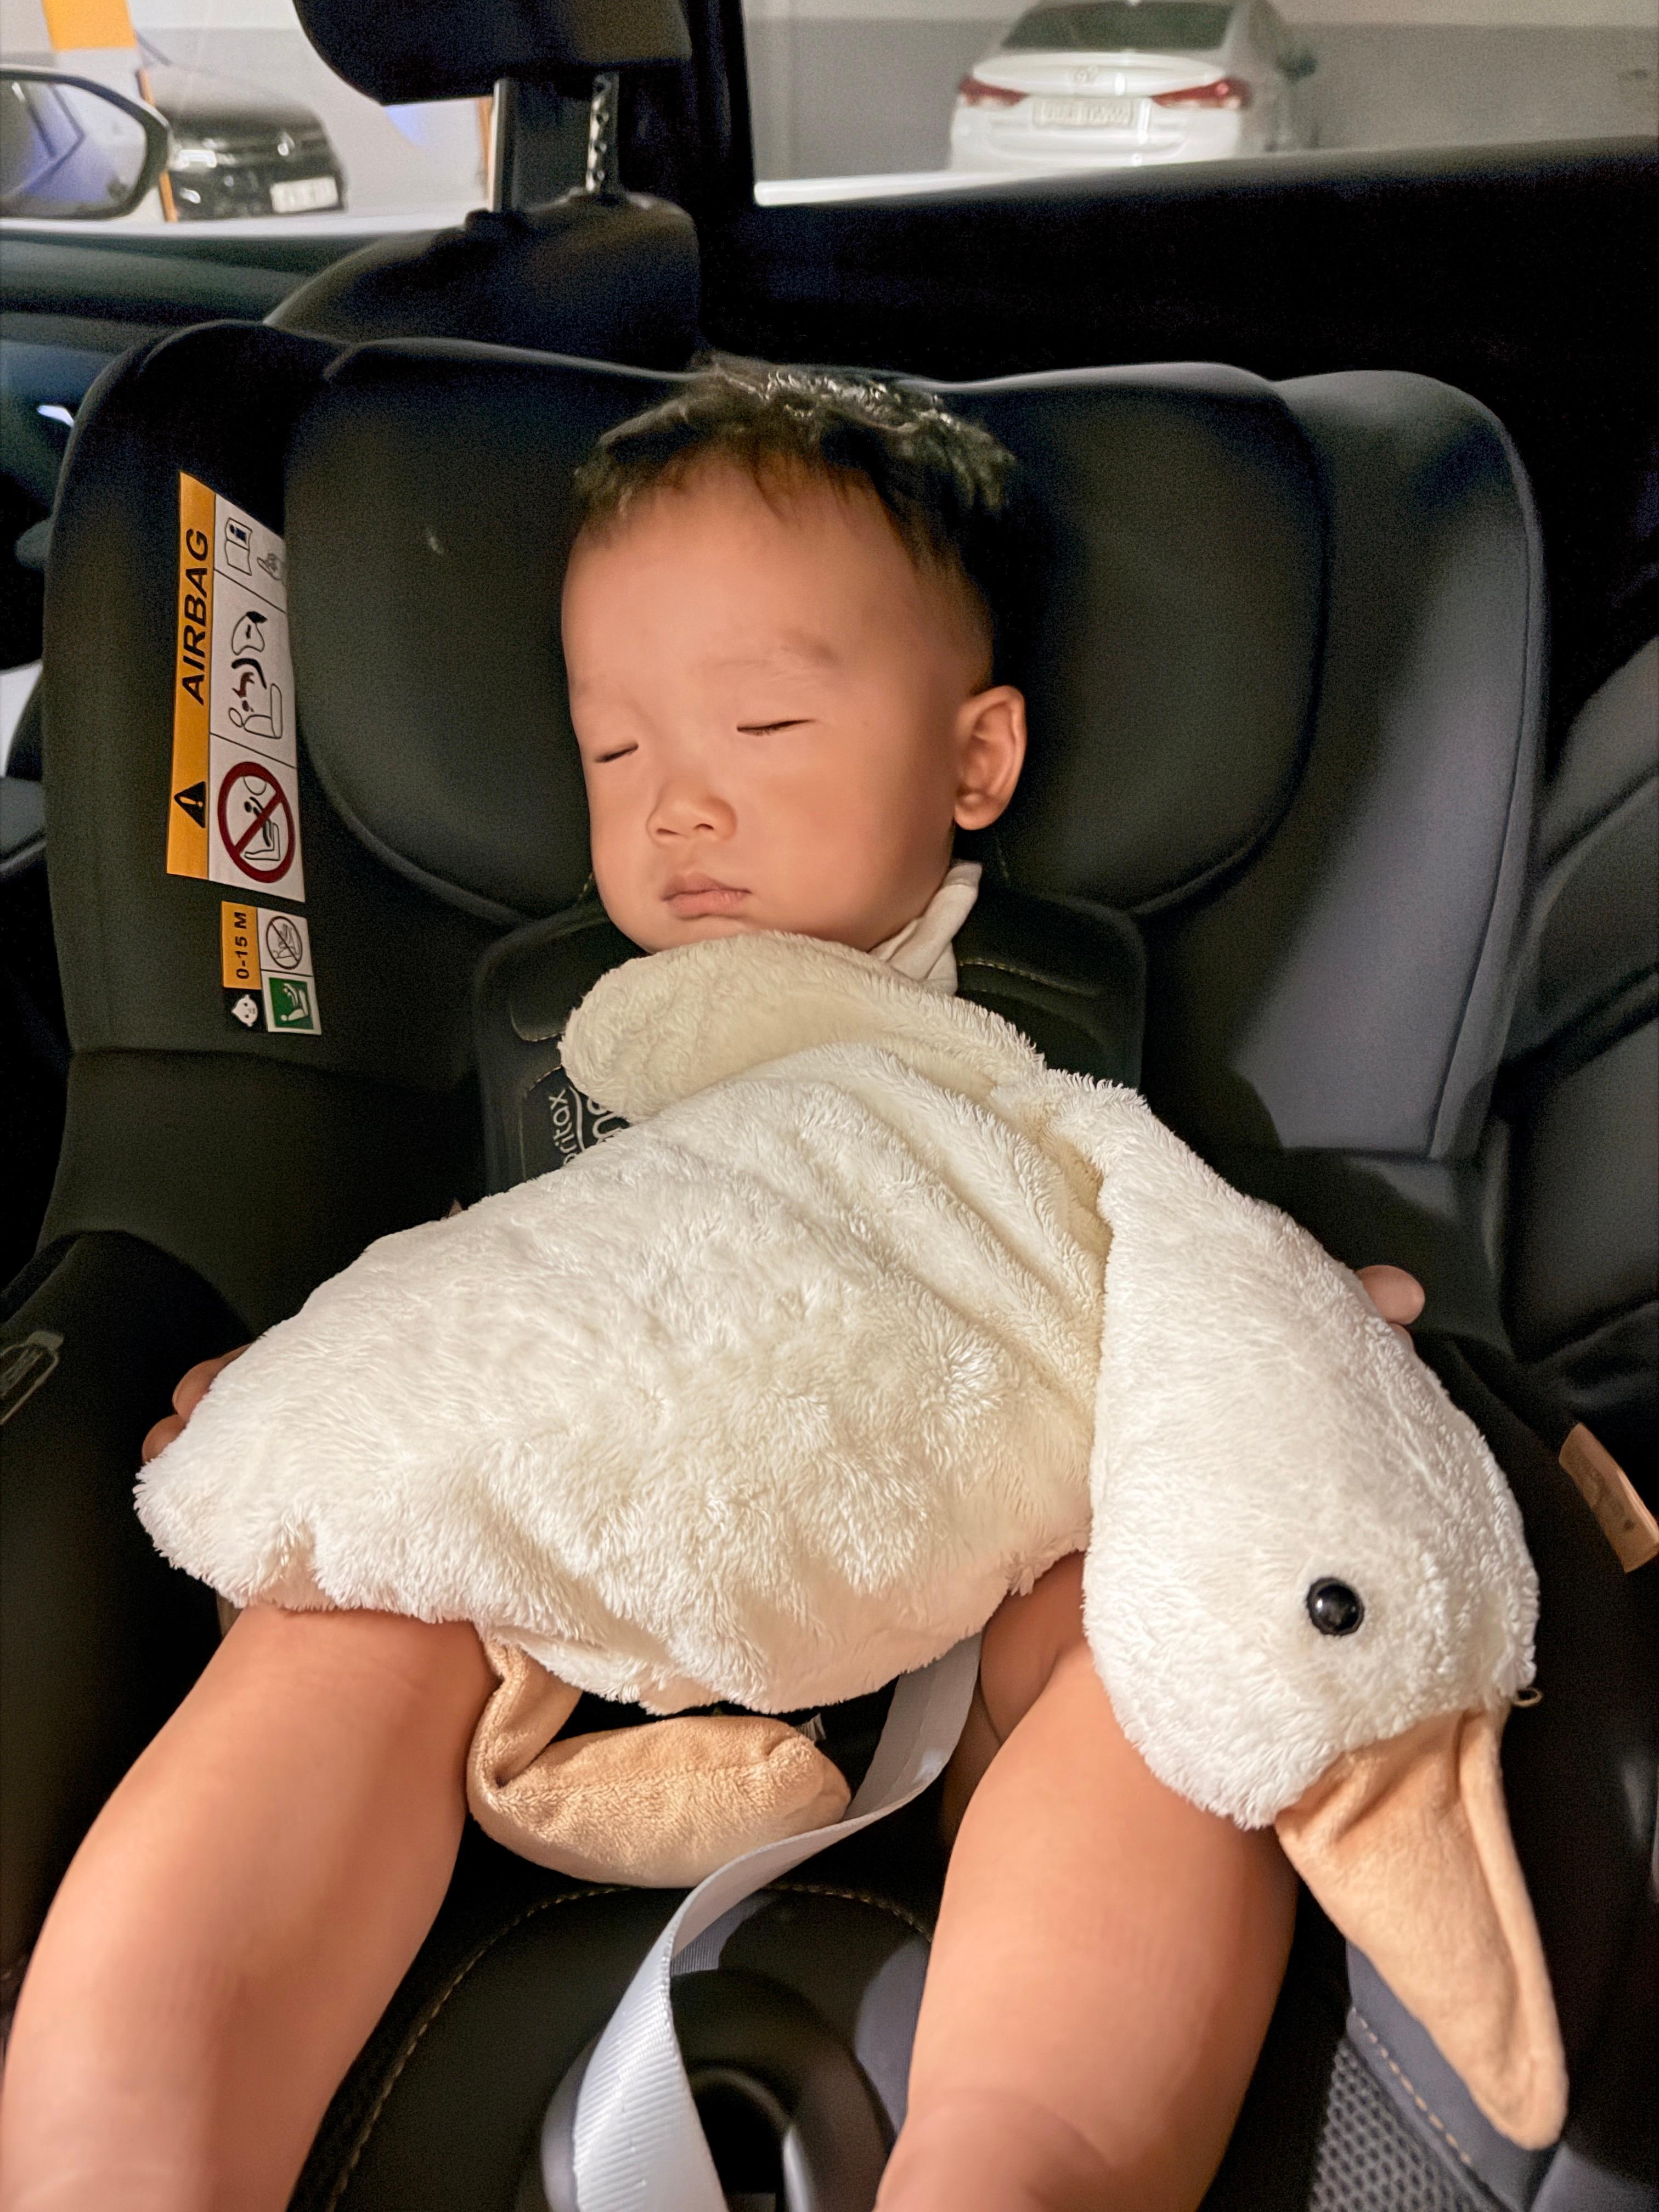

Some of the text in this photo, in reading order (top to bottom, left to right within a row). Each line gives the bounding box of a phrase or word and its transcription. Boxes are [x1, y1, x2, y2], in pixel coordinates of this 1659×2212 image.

[182, 528, 208, 706] AIRBAG
[234, 911, 250, 980] 0-15 M
